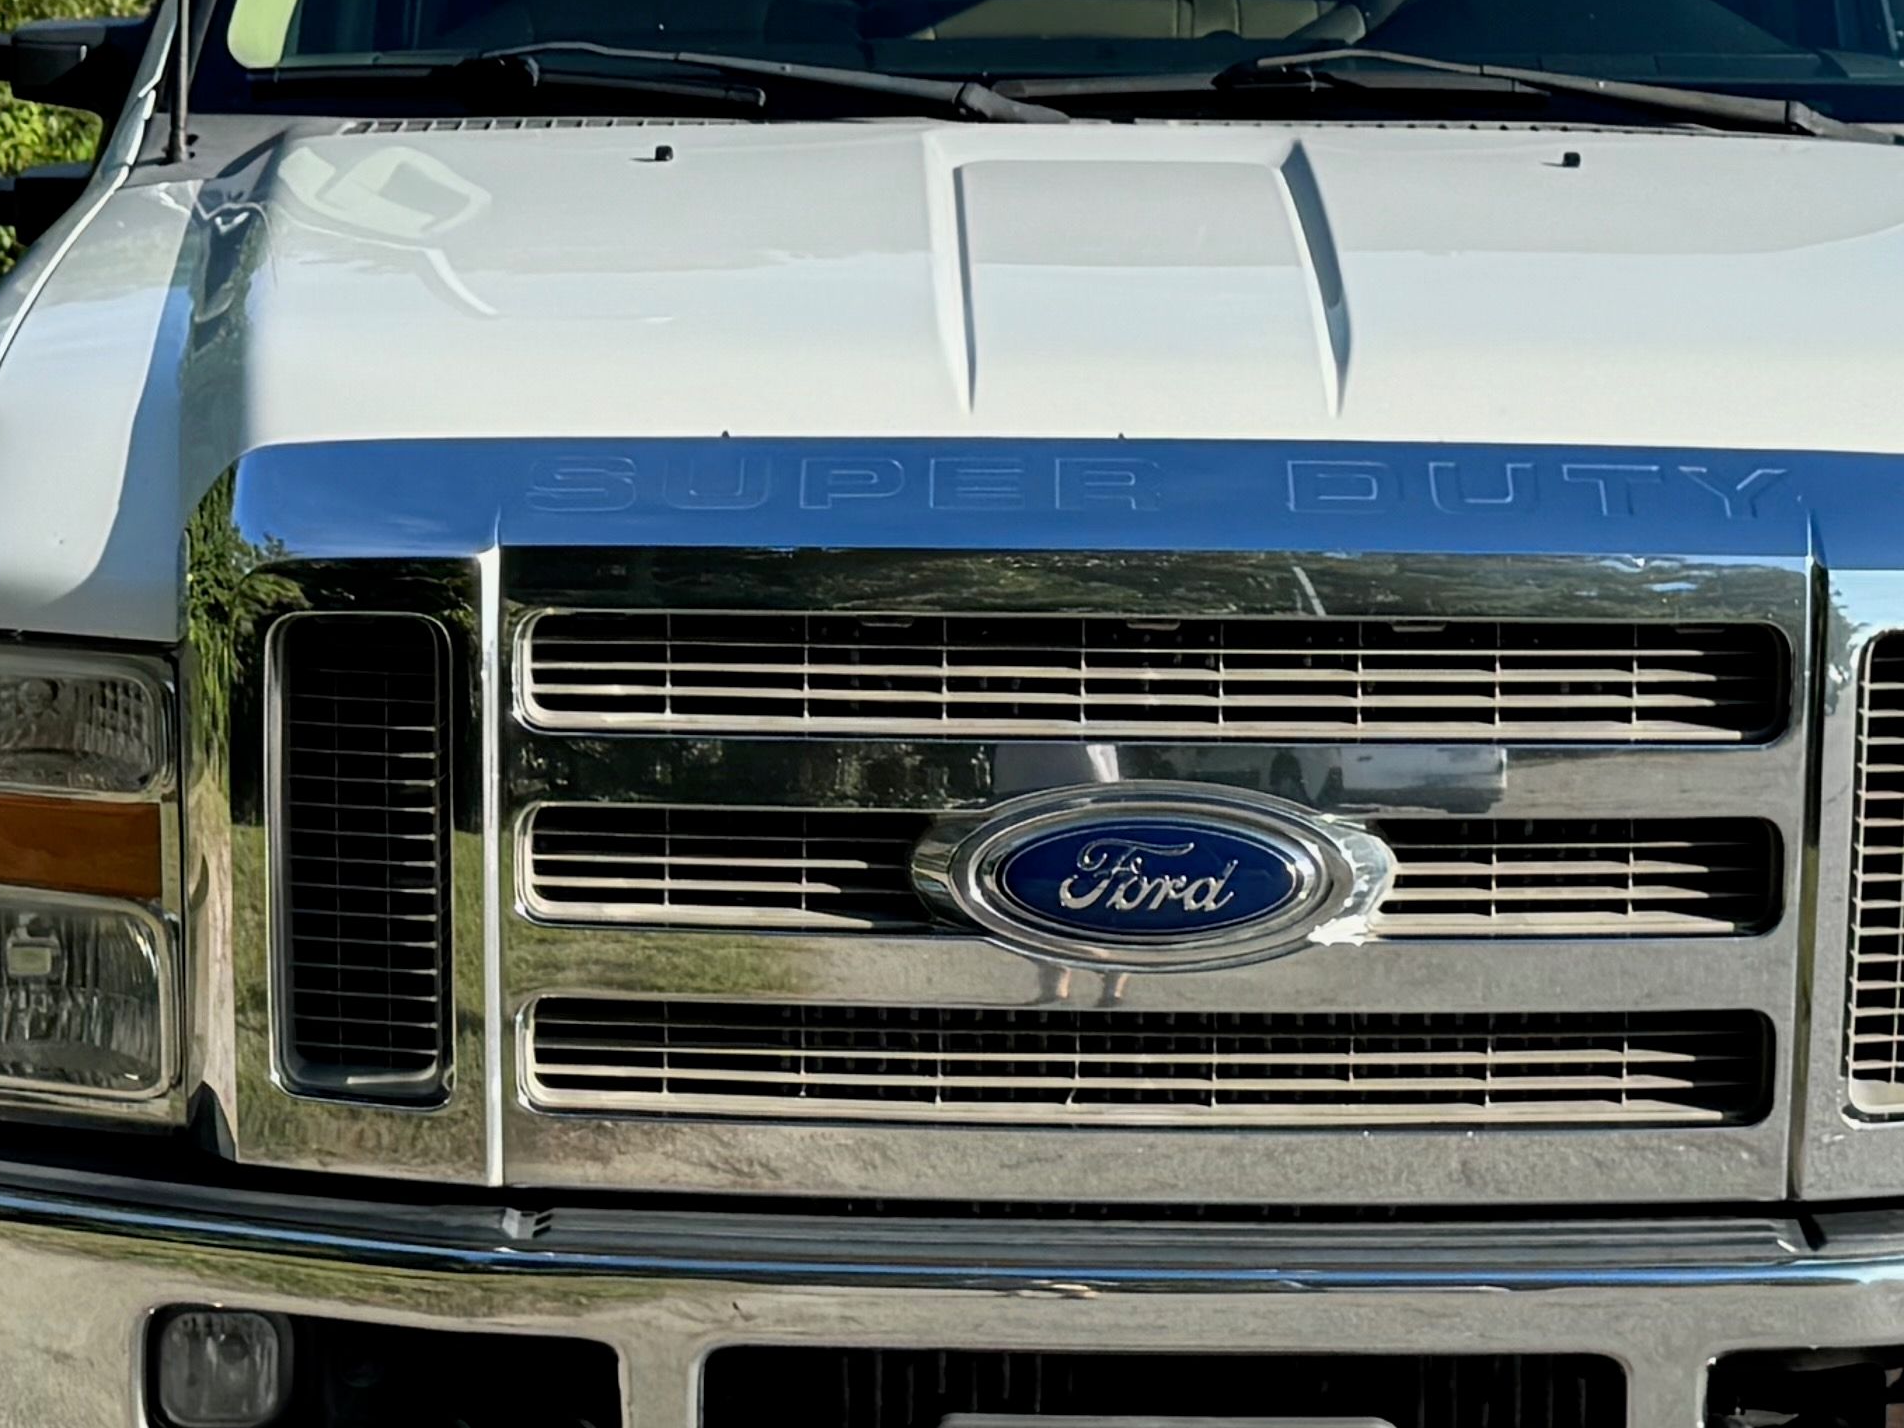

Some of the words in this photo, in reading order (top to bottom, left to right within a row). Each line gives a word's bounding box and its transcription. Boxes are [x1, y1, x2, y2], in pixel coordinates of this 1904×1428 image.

[525, 455, 1163, 514] SUPER
[1286, 460, 1790, 520] DUTY
[1058, 837, 1239, 912] Ford
